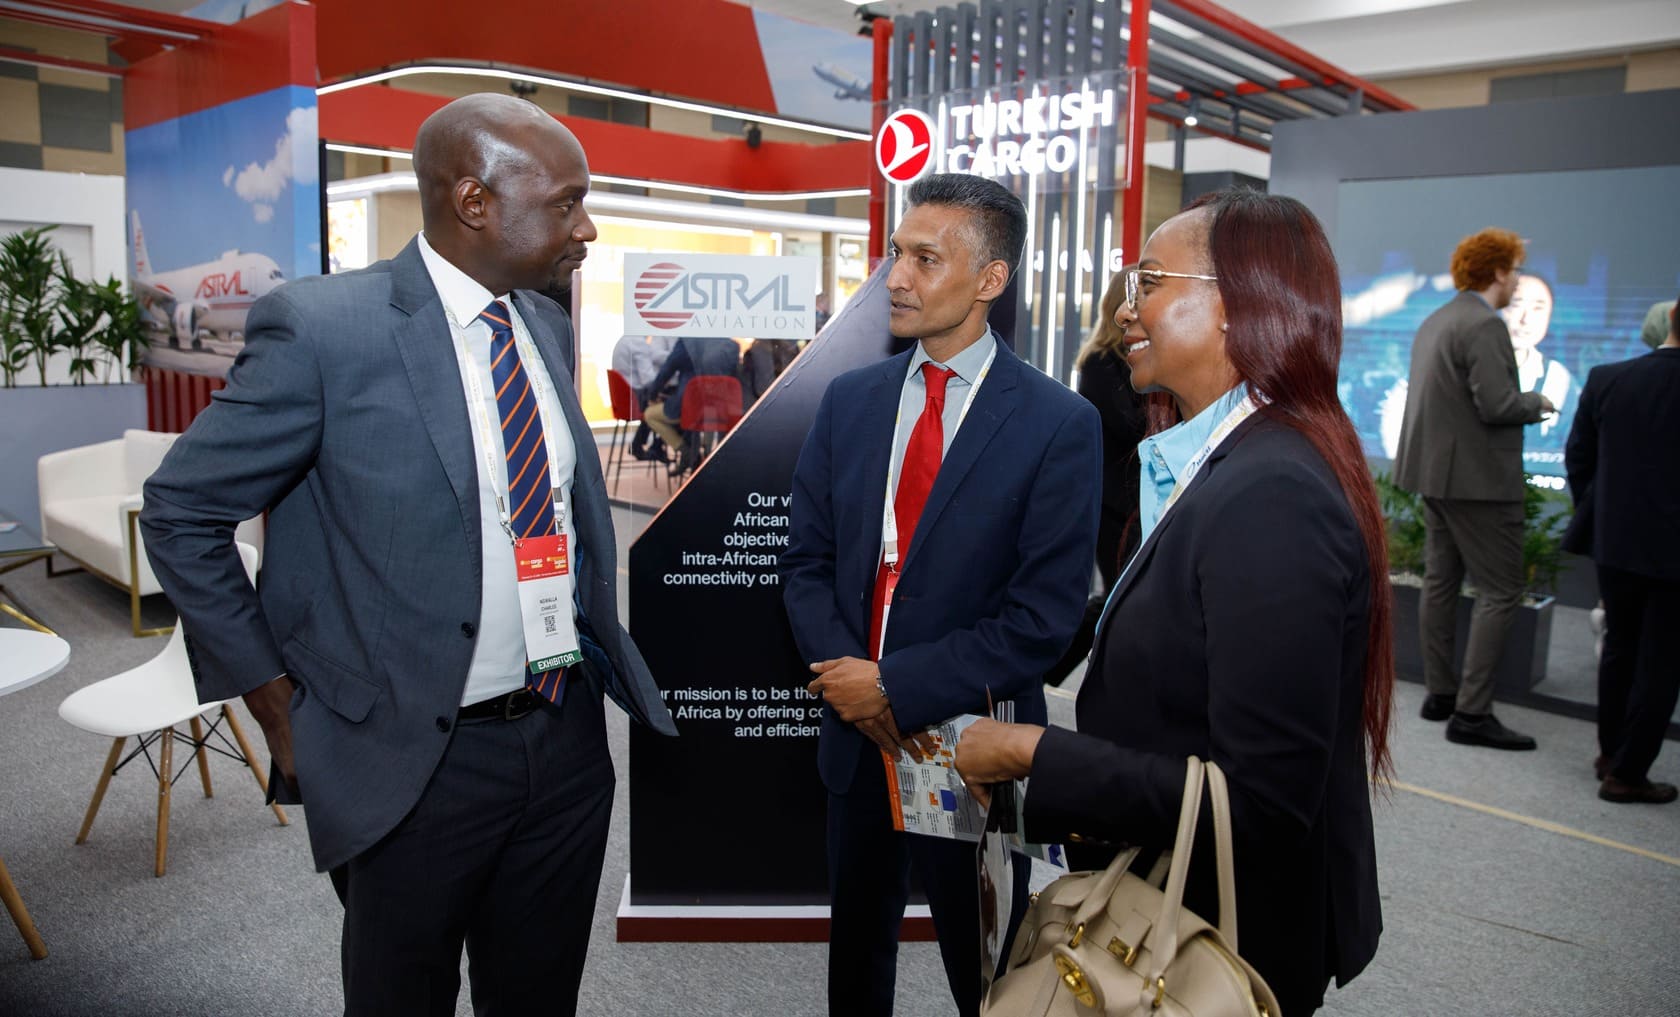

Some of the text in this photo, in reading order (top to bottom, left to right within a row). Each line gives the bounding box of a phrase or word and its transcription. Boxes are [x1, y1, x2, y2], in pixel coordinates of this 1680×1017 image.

[951, 89, 1113, 140] TURKISH
[948, 135, 1076, 177] CARGO
[195, 271, 249, 300] ASTRAL
[649, 272, 806, 312] ASTRAL
[690, 315, 806, 330] AVIATION
[747, 492, 777, 507] Our
[733, 512, 789, 527] African
[723, 532, 789, 549] objective
[682, 551, 777, 566] intra-African
[663, 571, 779, 588] connectivity on
[537, 652, 575, 670] EXHIBITOR
[674, 687, 731, 700] mission
[735, 687, 747, 700] is
[752, 688, 767, 700] to
[771, 687, 790, 700] be
[676, 706, 722, 718] Africa
[725, 706, 744, 721] by
[747, 705, 804, 721] offering
[734, 724, 762, 737] and
